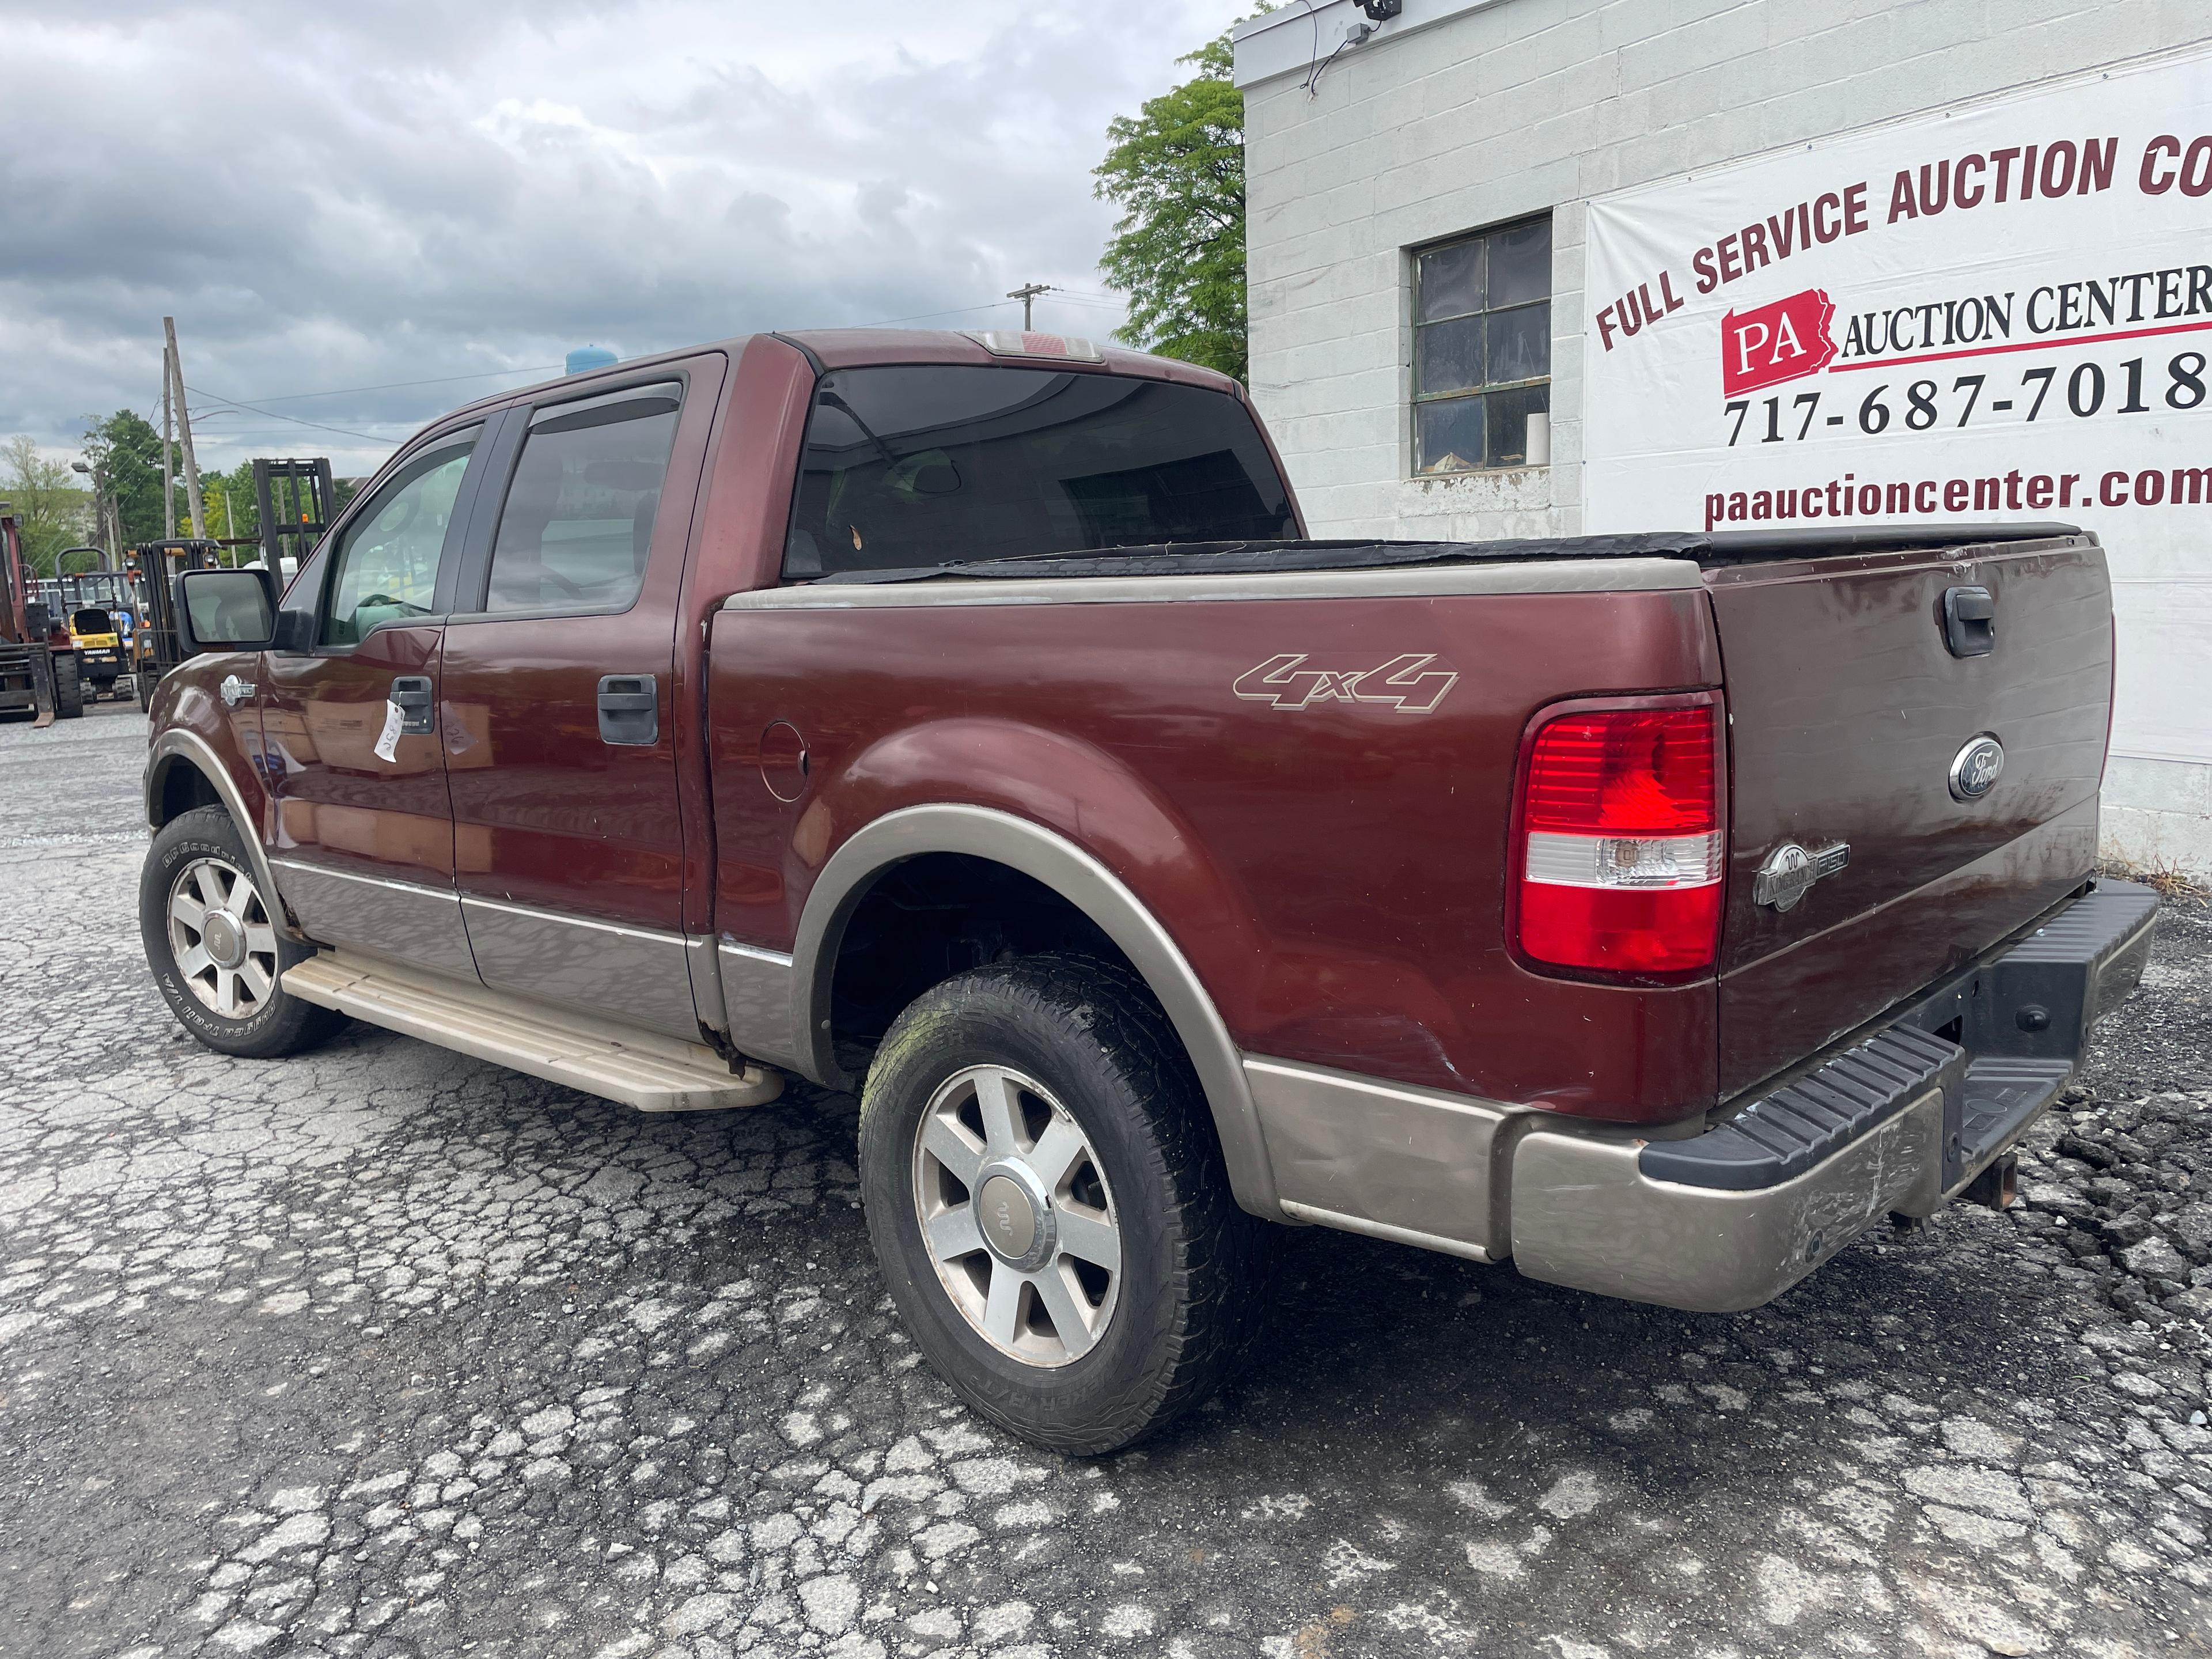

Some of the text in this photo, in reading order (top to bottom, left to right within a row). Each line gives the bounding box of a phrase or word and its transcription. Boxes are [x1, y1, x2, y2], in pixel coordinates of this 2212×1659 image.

[1596, 270, 1684, 352] FULL
[1692, 181, 1869, 294] SERVICE
[1887, 137, 2119, 224] AUCTION
[1733, 265, 2212, 375] PA AUCTION CENTER
[1724, 352, 2206, 446] 717-687-7018
[1705, 467, 2212, 532] paauctioncenter.com
[1233, 654, 1460, 714] 4x4
[1972, 750, 1999, 788] Ford
